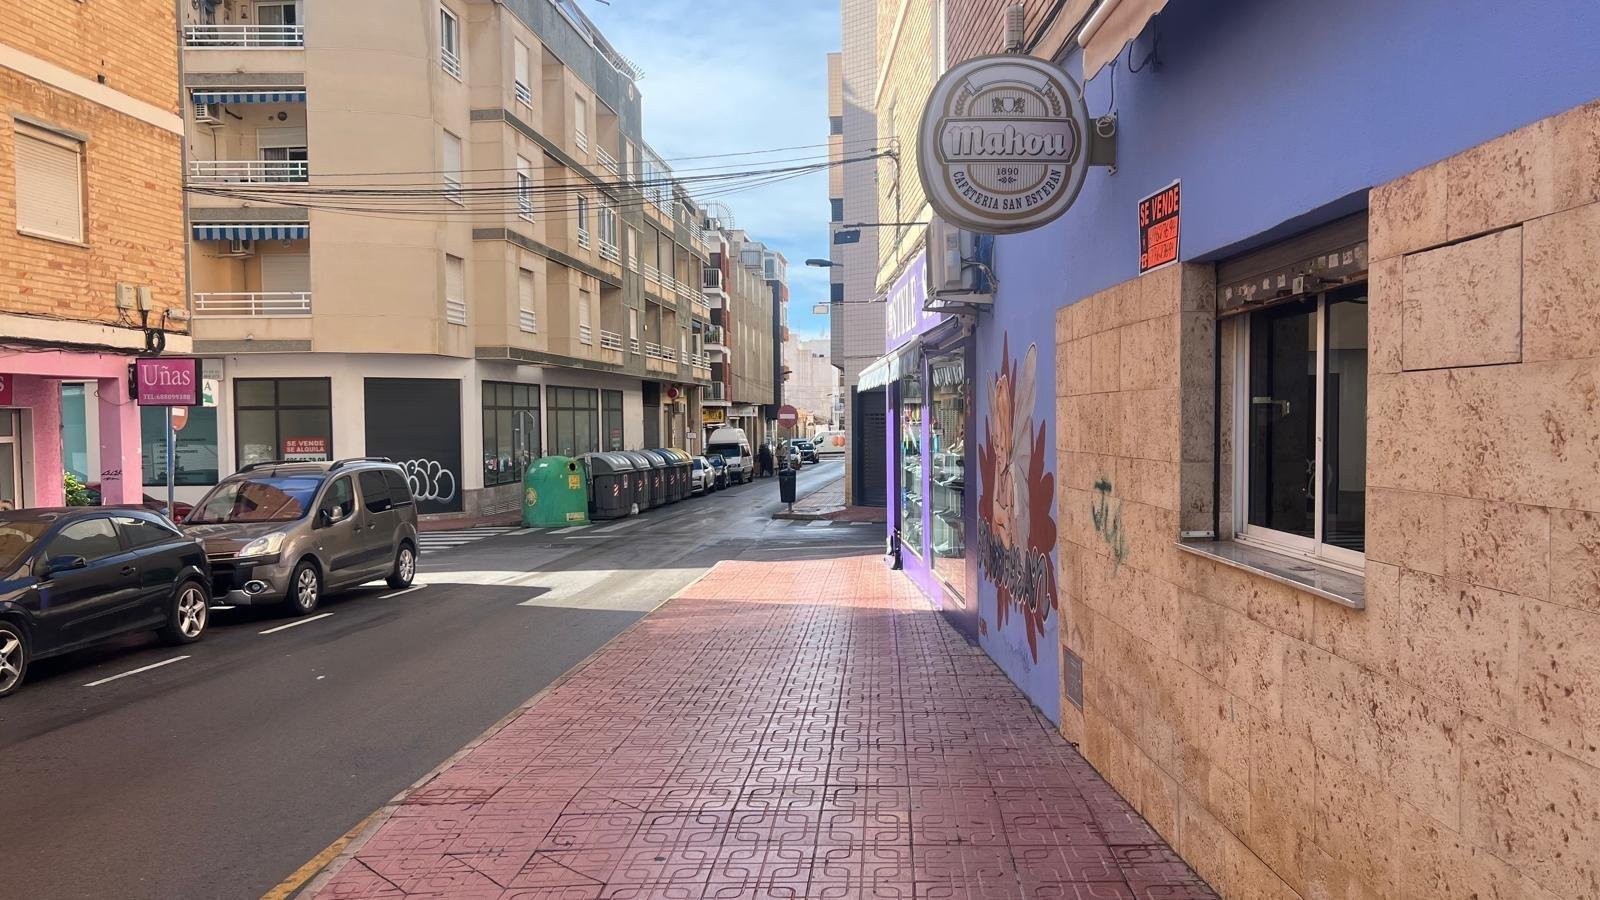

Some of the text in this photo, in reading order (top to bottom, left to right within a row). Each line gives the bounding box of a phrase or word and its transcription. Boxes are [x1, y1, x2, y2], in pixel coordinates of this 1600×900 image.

[947, 124, 1067, 157] Mahou
[996, 167, 1020, 176] 1890
[952, 169, 1062, 211] CAFETERIA SAN ESTEBAN
[1140, 186, 1180, 227] SE VENDE
[141, 364, 191, 386] Uñas
